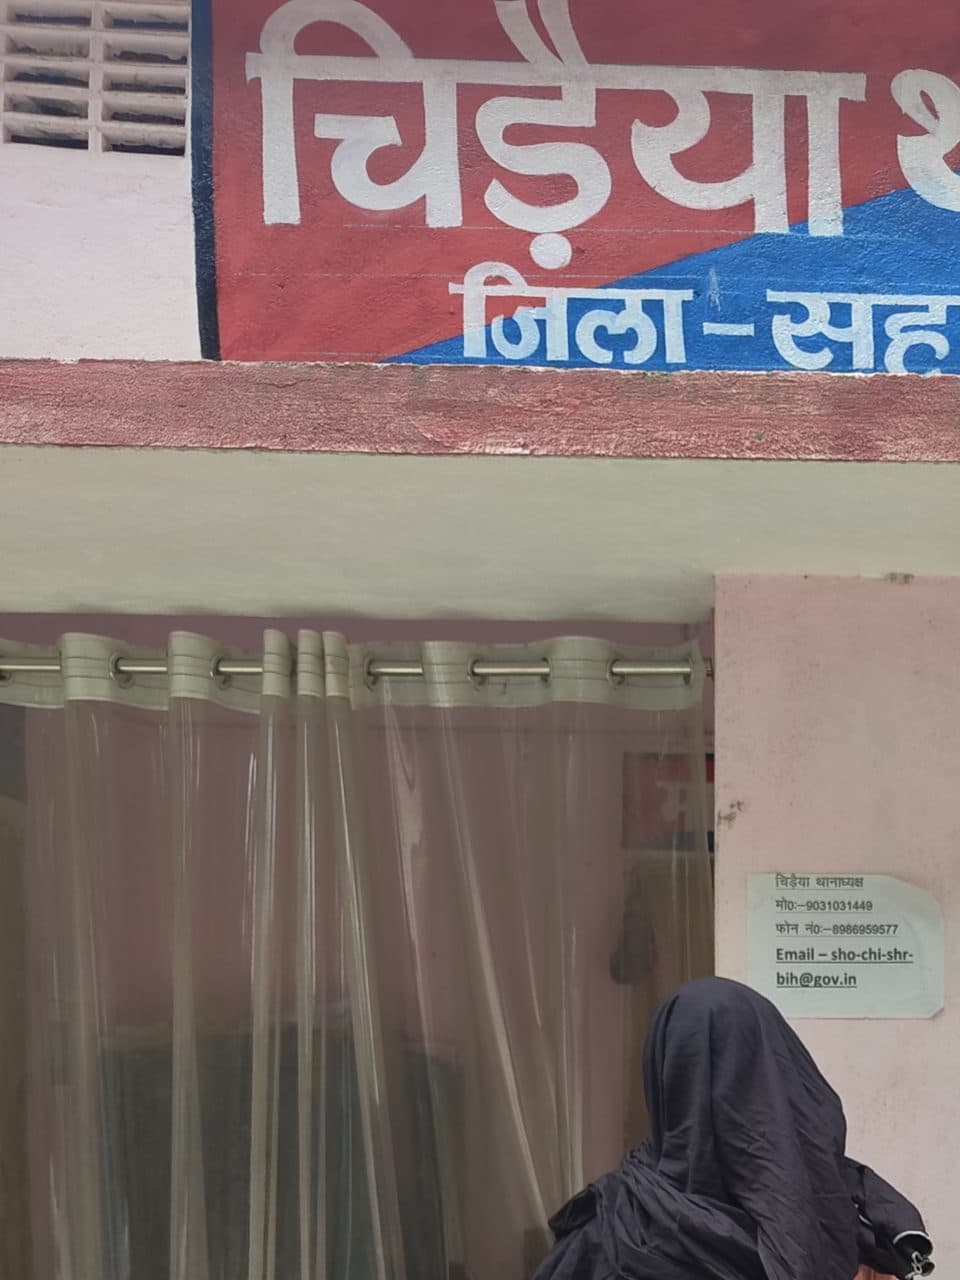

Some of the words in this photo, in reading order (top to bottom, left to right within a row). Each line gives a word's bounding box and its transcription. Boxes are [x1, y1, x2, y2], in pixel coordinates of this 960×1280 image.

[449, 261, 694, 365] जिला
[816, 876, 864, 888] थानाध्यक्ष
[776, 920, 799, 934] फोन
[776, 948, 814, 961] Email
[831, 948, 913, 961] sho-chi-shr-
[776, 972, 857, 987] bih@gov.in
